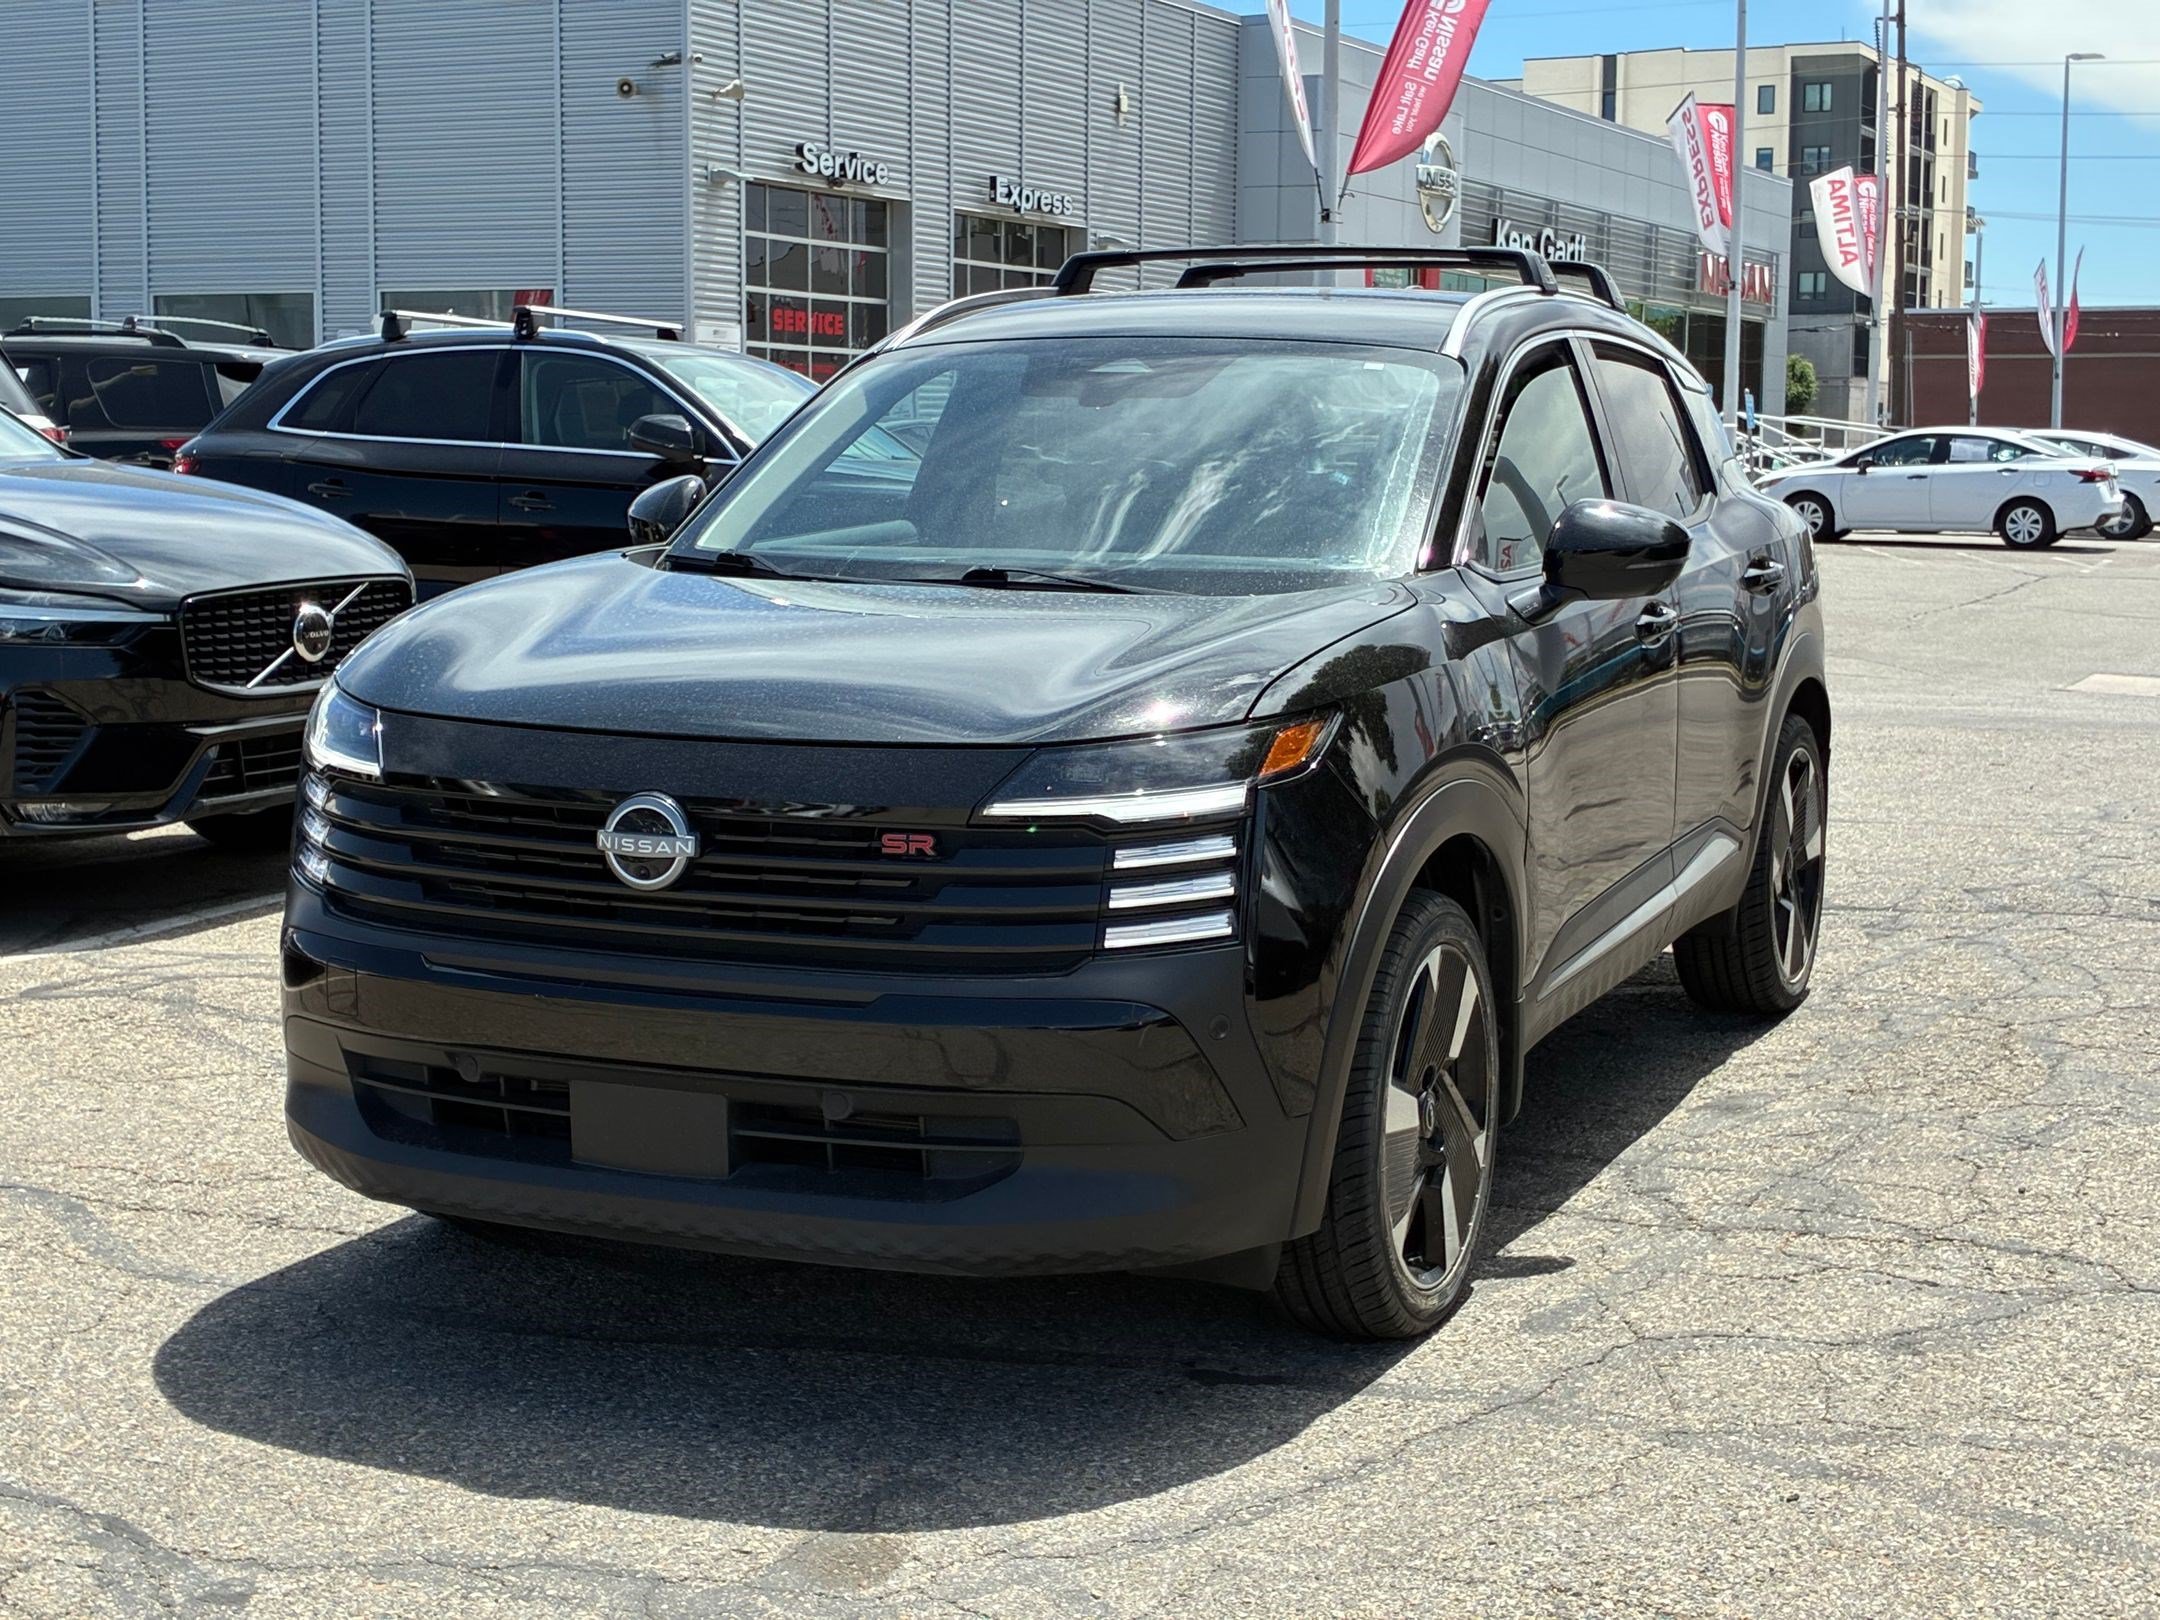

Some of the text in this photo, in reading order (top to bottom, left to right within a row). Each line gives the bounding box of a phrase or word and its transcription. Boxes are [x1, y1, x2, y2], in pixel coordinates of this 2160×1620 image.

[802, 142, 889, 185] Service
[995, 176, 1073, 215] Express
[1496, 218, 1586, 262] Ken Garff
[773, 308, 844, 335] SERVICE
[303, 629, 329, 639] VOLVO
[599, 834, 692, 854] NISSAN
[881, 833, 937, 856] SR
